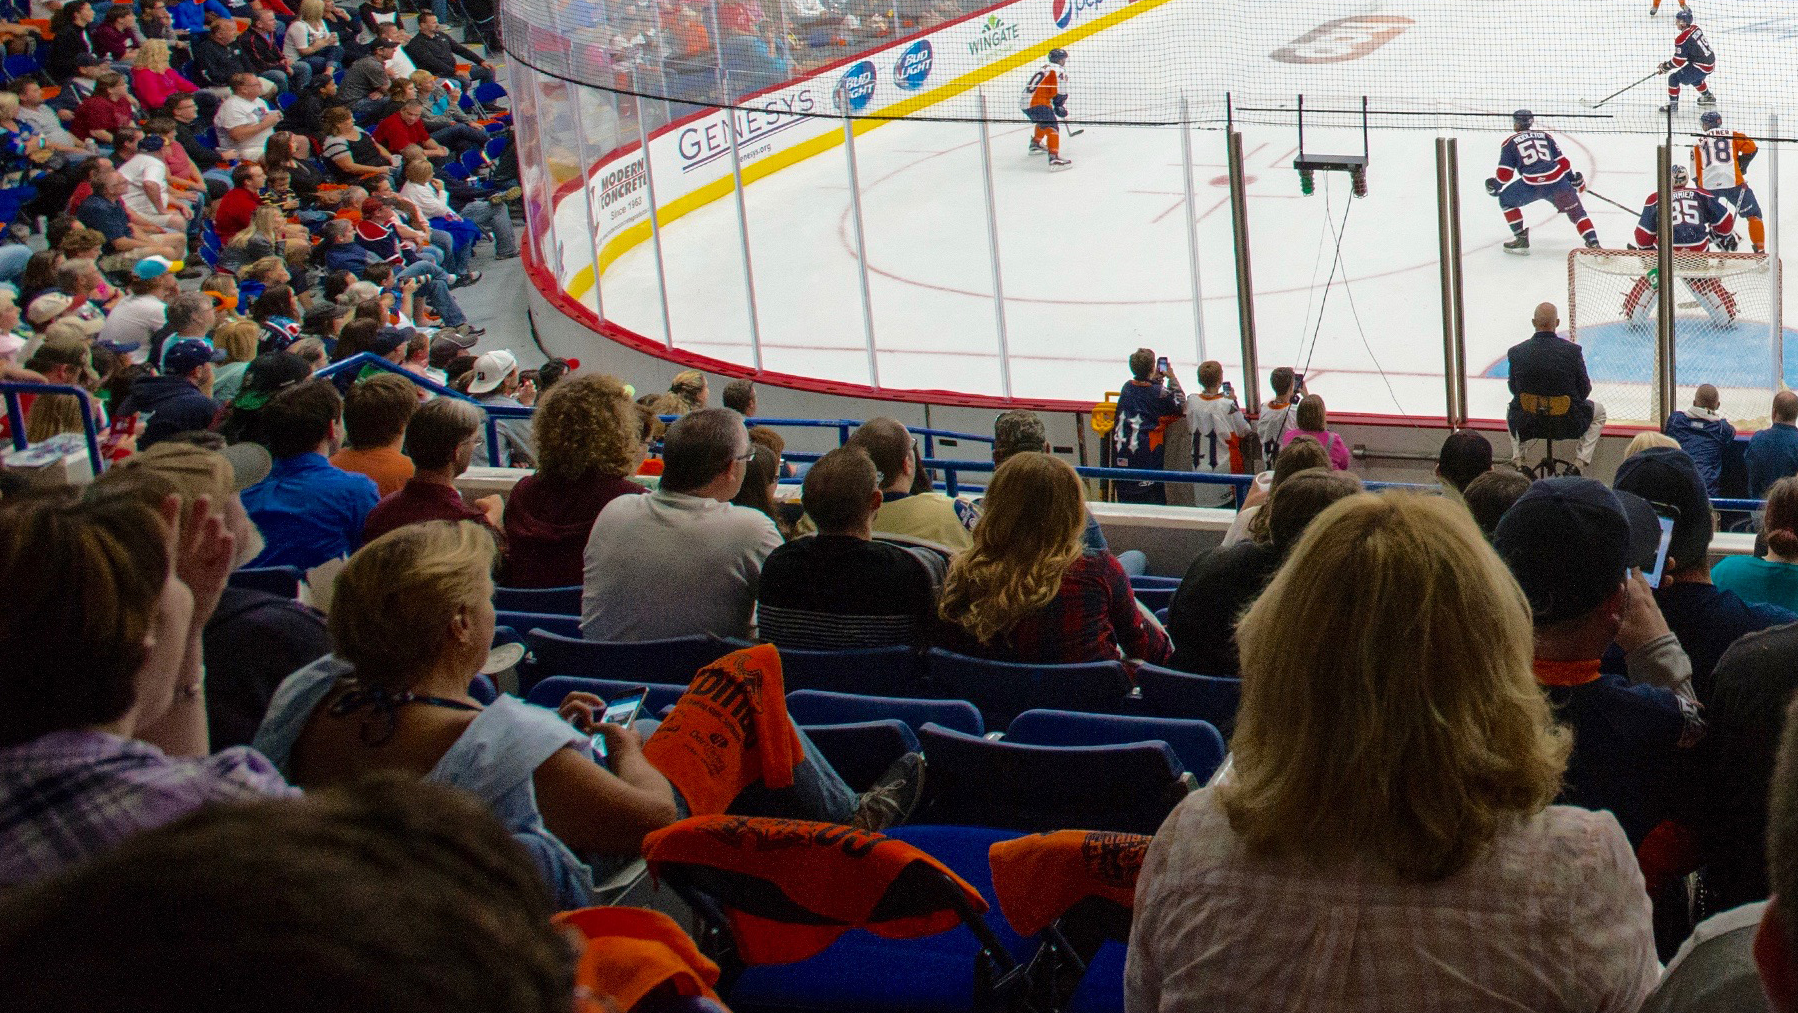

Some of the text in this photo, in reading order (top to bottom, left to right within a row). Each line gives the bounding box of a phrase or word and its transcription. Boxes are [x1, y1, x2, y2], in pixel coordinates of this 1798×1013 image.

[968, 24, 1020, 56] WINGATE
[899, 59, 932, 80] LIGHT
[905, 49, 929, 66] BUD
[845, 70, 871, 89] BUD
[850, 83, 875, 99] GHT
[678, 89, 815, 161] GENESYS
[738, 143, 772, 163] enesys.org
[1516, 139, 1552, 166] 55
[1702, 136, 1731, 167] 18
[601, 157, 645, 192] MODERN
[610, 196, 643, 221] Since 1963
